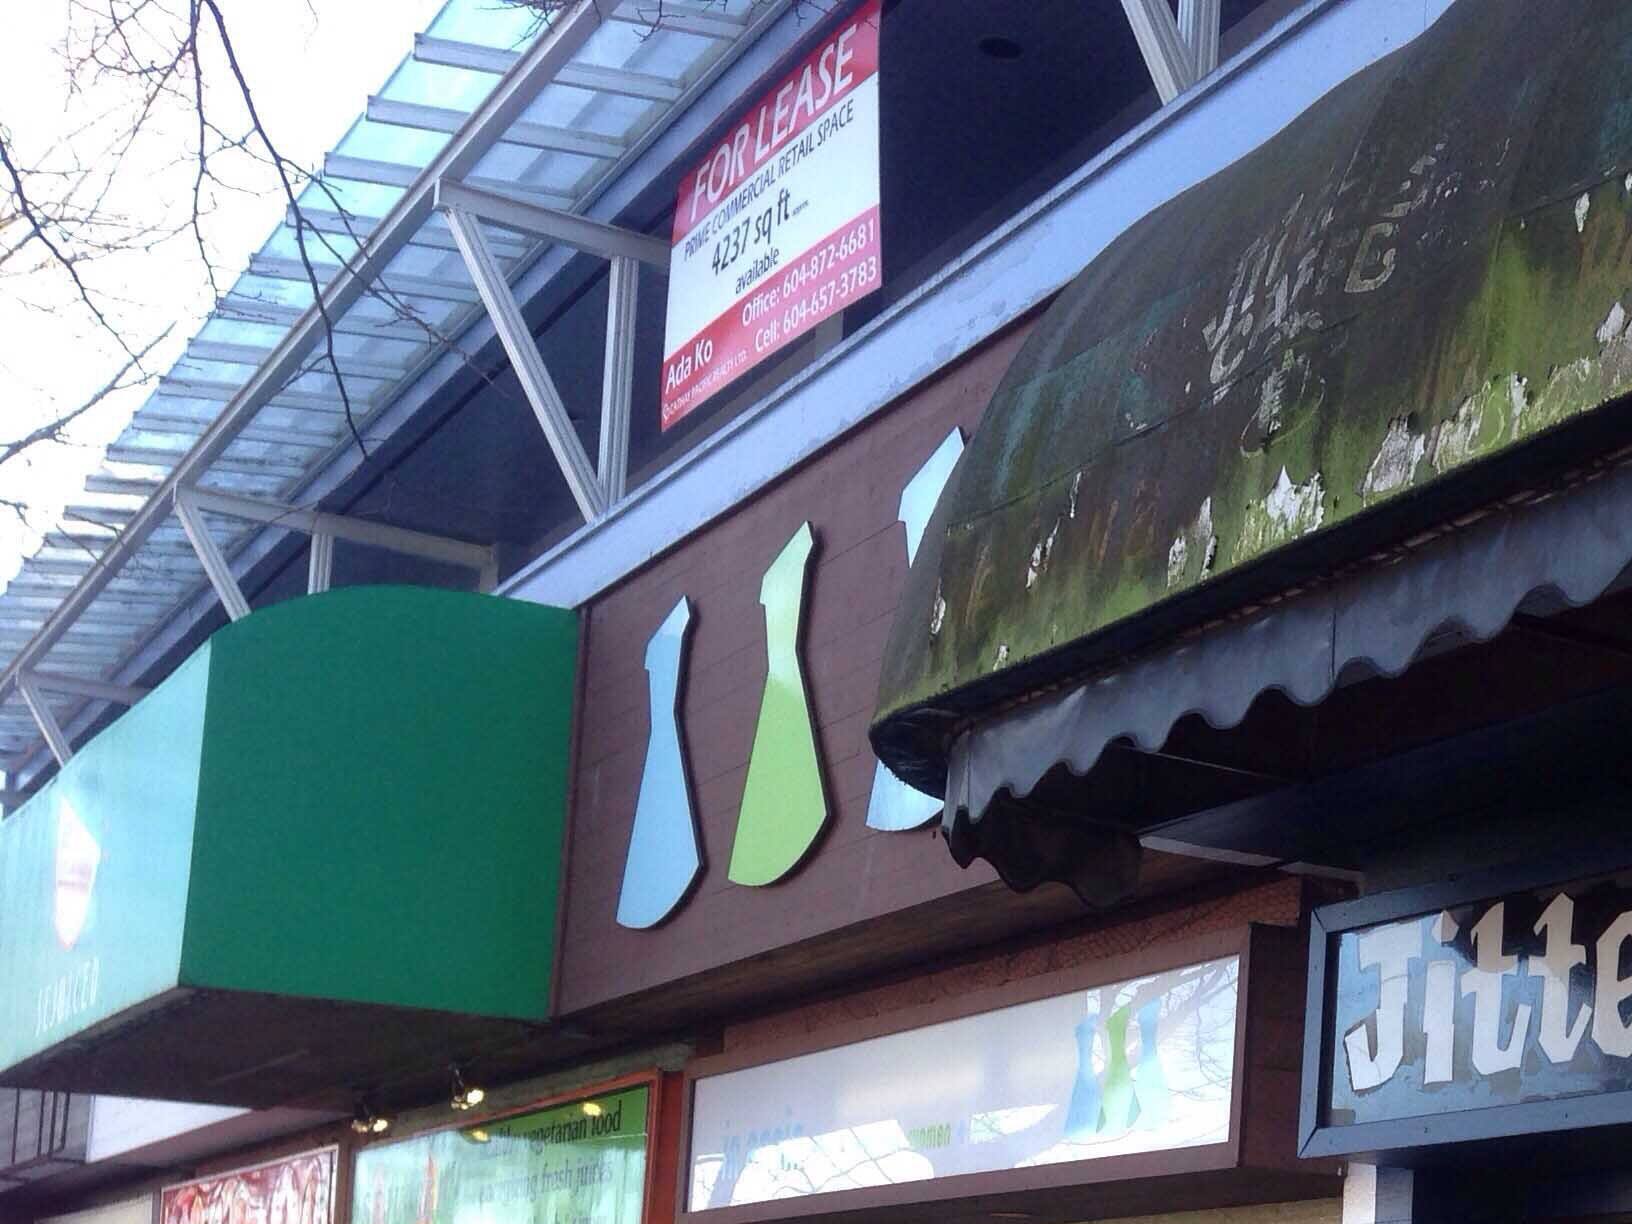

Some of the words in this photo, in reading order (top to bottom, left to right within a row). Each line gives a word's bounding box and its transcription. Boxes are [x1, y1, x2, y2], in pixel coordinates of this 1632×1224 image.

[690, 131, 746, 223] FOR
[754, 25, 857, 167] LEASE
[683, 223, 712, 262] PRIME
[711, 169, 776, 237] COMMERCIAL
[778, 141, 815, 180] RETAIL
[815, 99, 855, 148] SPACE
[711, 217, 750, 277] 4237
[754, 214, 773, 251] sq
[776, 189, 792, 229] ft
[735, 247, 780, 295] available
[742, 283, 781, 328] Office:
[783, 217, 876, 298] 604-872-6681
[755, 317, 781, 354] Cell:
[783, 255, 878, 337] 604-657-3783
[665, 355, 692, 394] Ada
[694, 338, 713, 372] Ko
